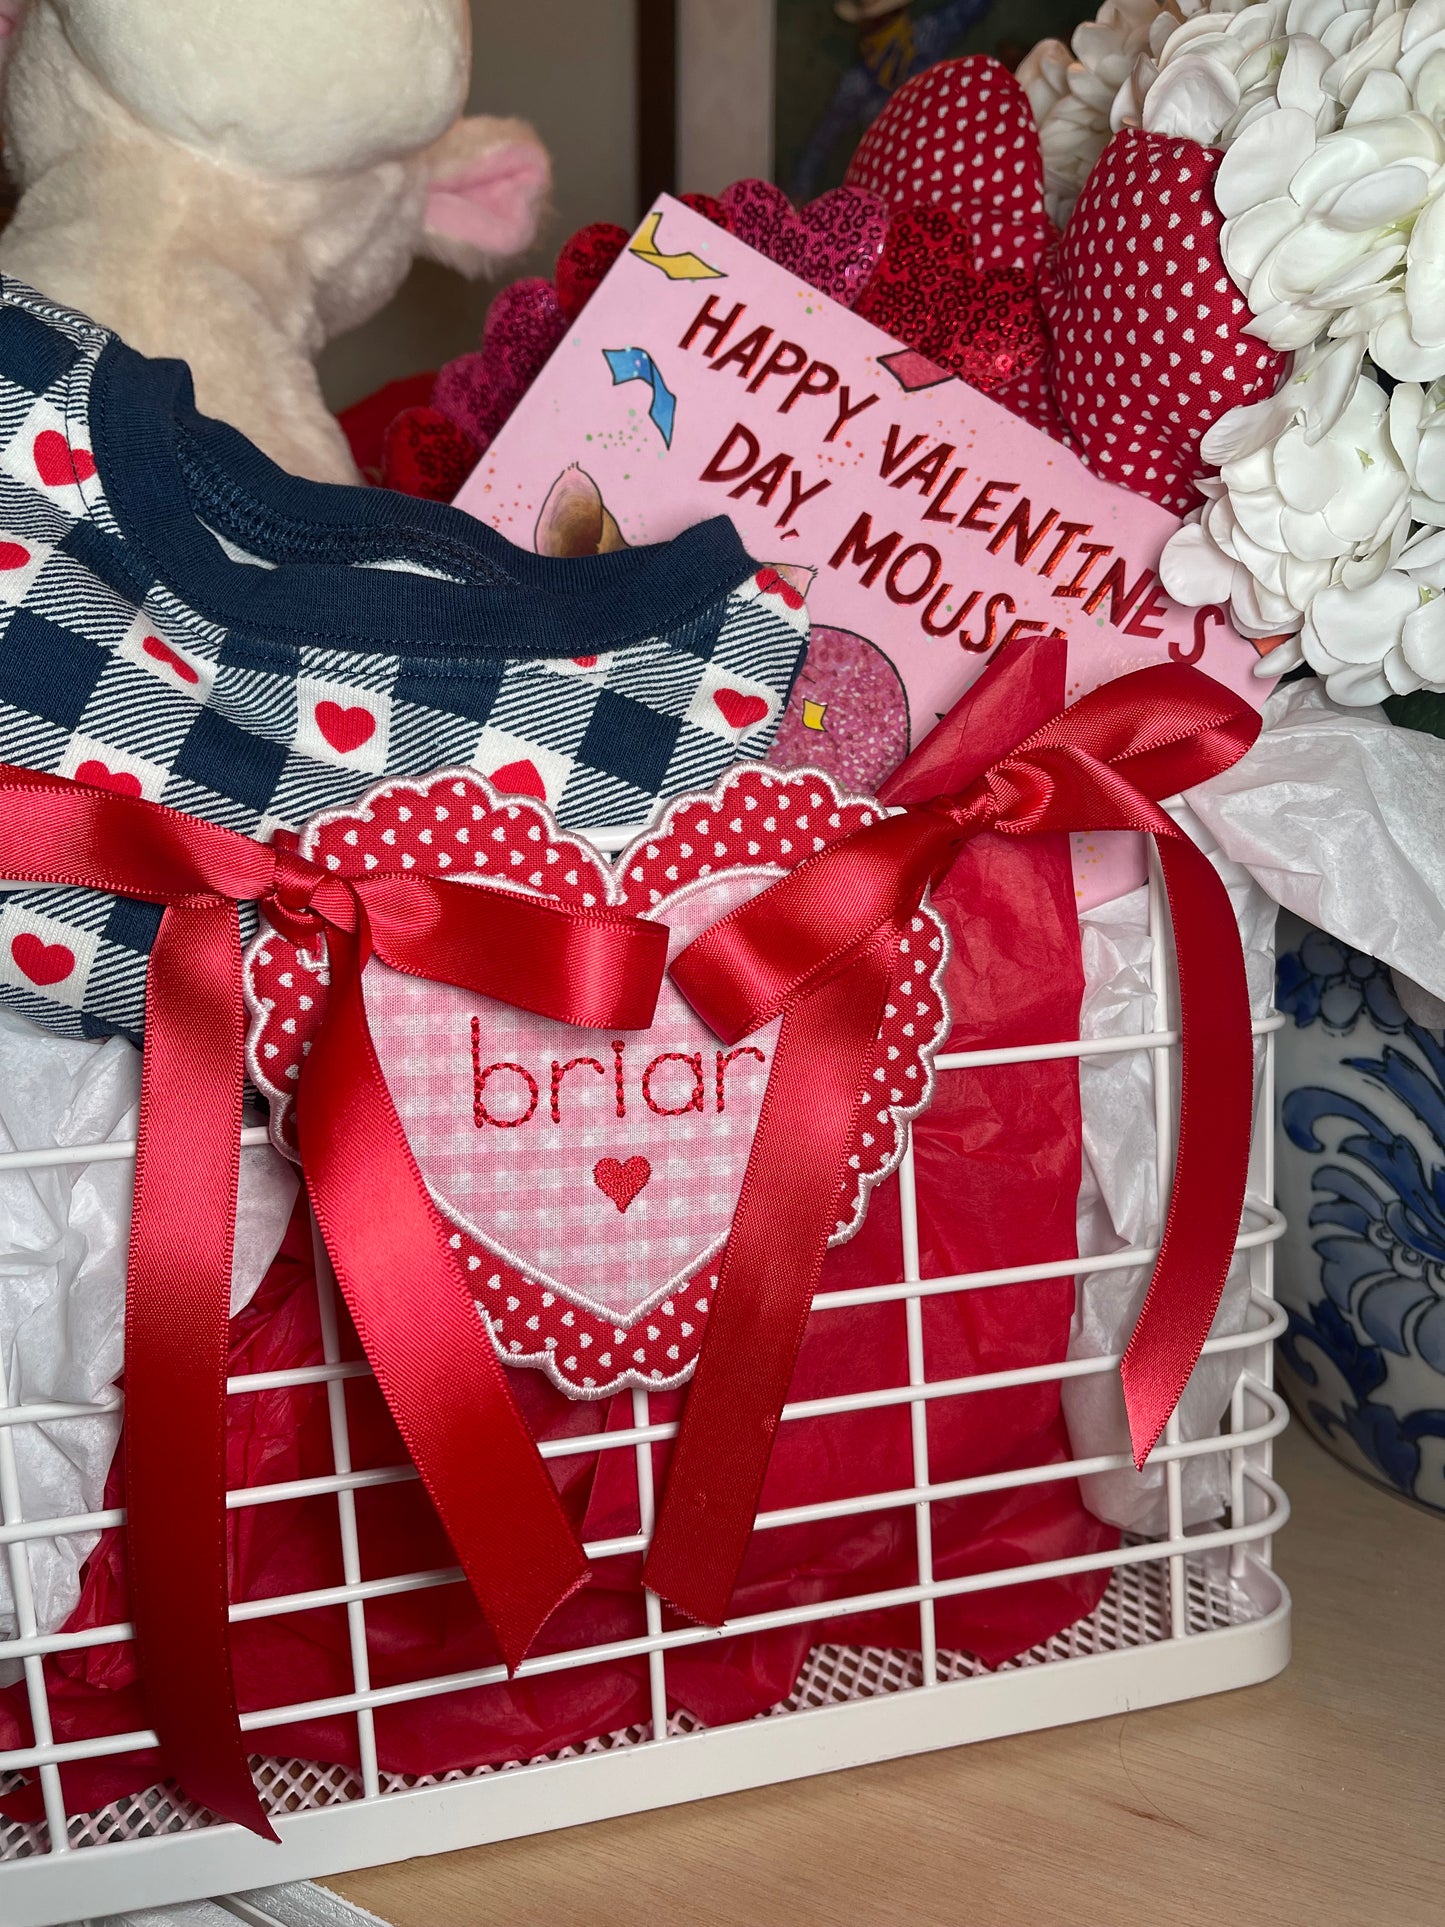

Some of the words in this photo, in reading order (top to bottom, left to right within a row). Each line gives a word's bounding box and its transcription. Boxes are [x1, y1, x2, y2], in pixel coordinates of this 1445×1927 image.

[679, 294, 880, 443] HAPPY
[878, 423, 1226, 665] VALENTINES
[698, 422, 833, 541] DAY,
[827, 512, 1069, 668] MOUS
[470, 1015, 766, 1129] briar
